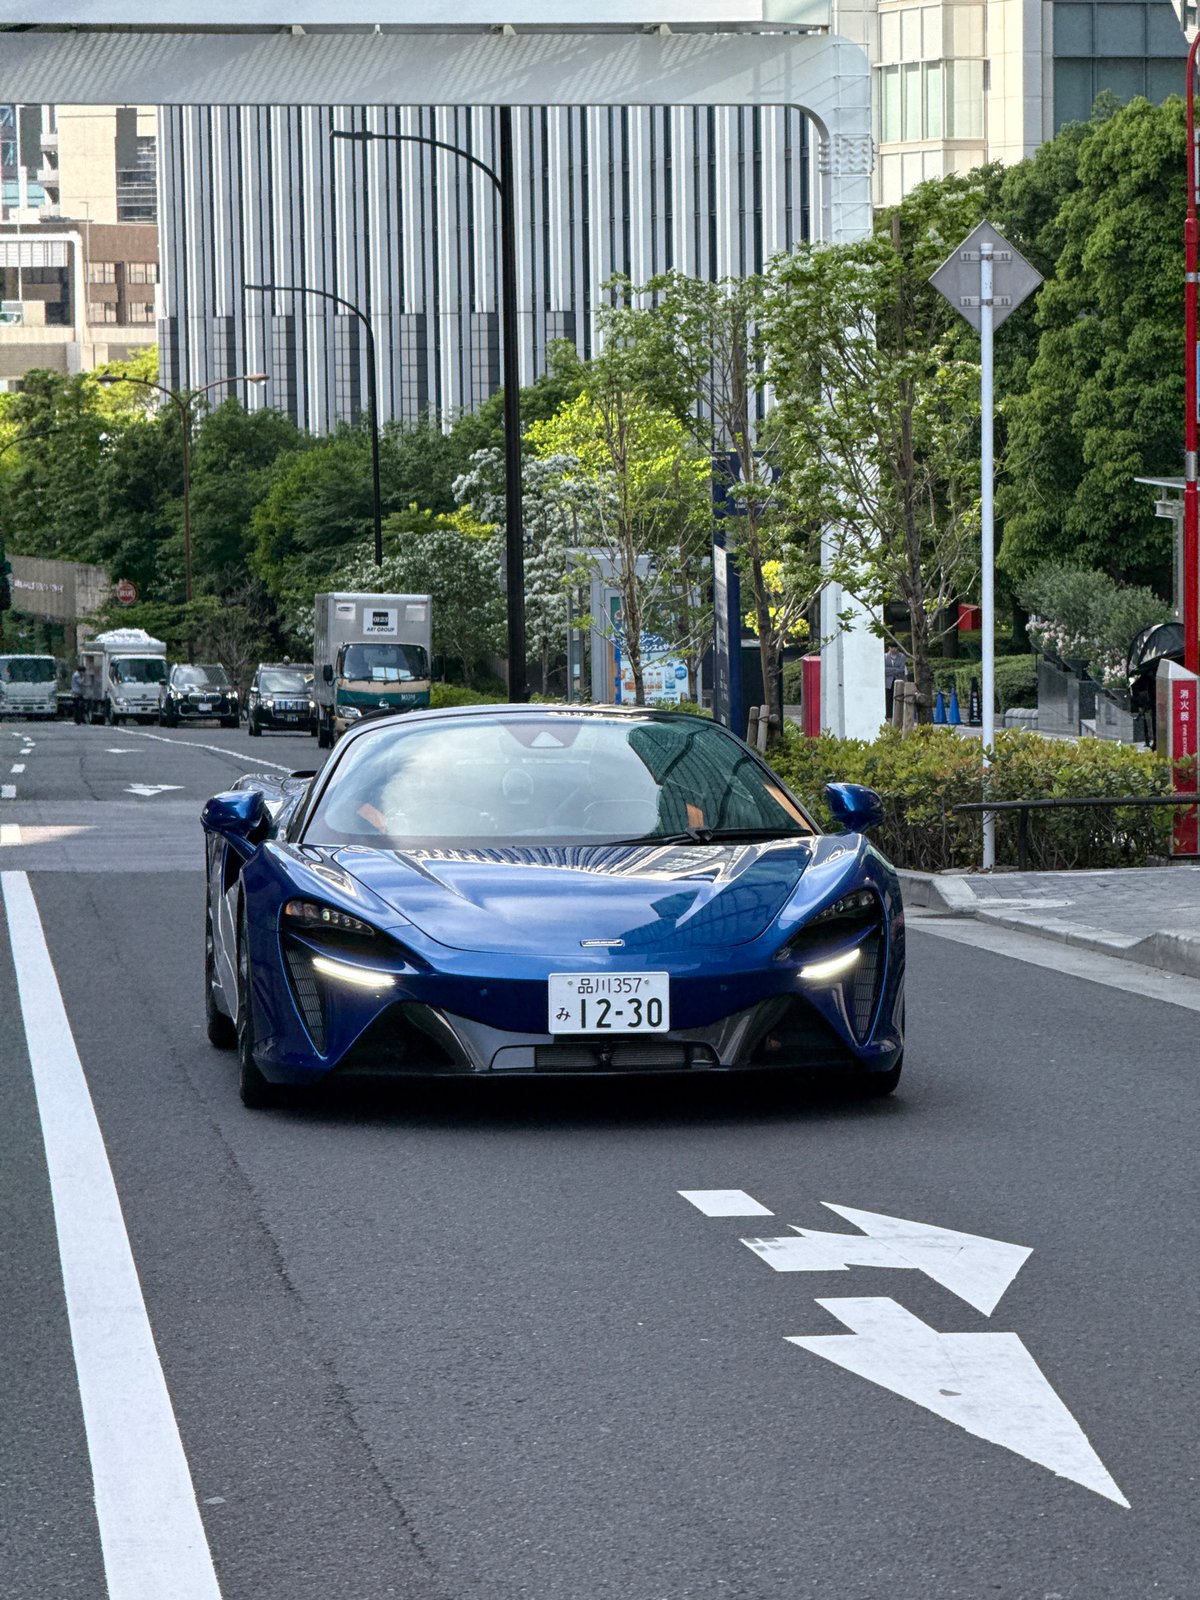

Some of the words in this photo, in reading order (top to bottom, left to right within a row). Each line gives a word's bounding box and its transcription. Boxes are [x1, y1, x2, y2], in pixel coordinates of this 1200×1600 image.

[1180, 689, 1189, 721] 消火器
[555, 1007, 571, 1021] み
[581, 997, 662, 1029] 12-30
